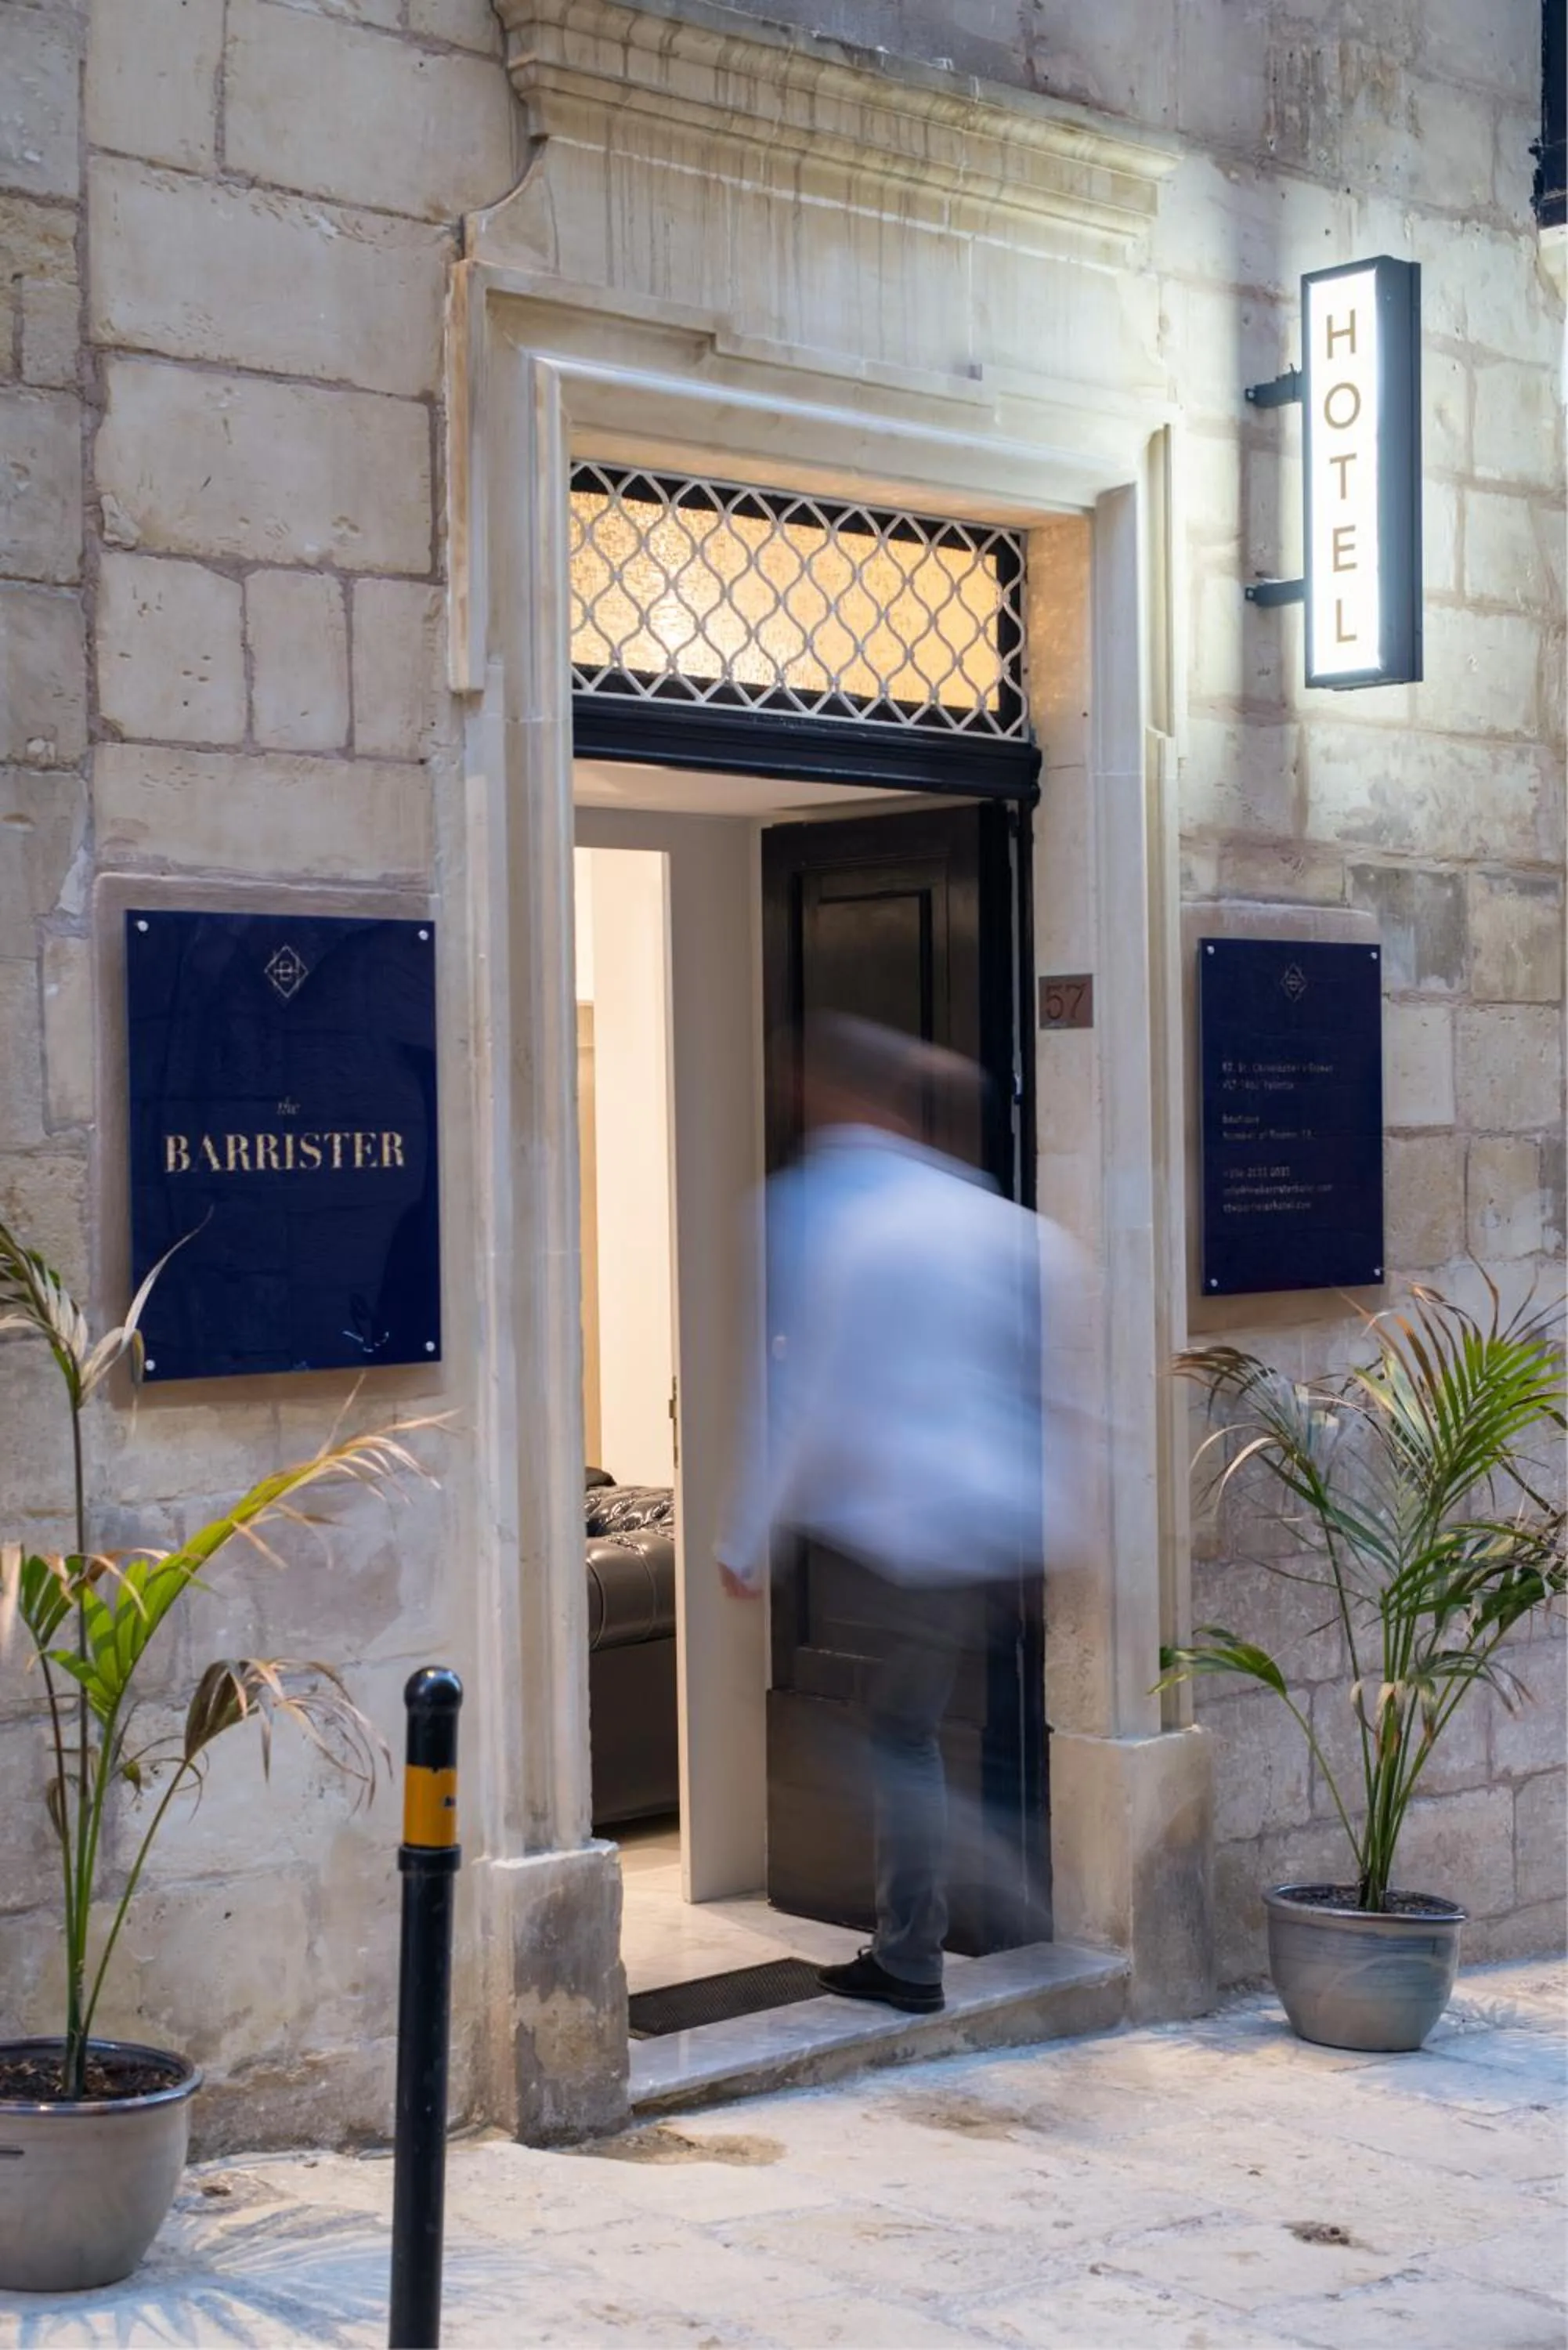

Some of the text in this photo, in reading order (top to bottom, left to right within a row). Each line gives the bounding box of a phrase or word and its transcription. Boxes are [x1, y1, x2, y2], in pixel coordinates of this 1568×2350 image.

[1324, 309, 1361, 643] HOTEL
[1045, 983, 1086, 1020] 57
[164, 1131, 405, 1173] BARRISTER
